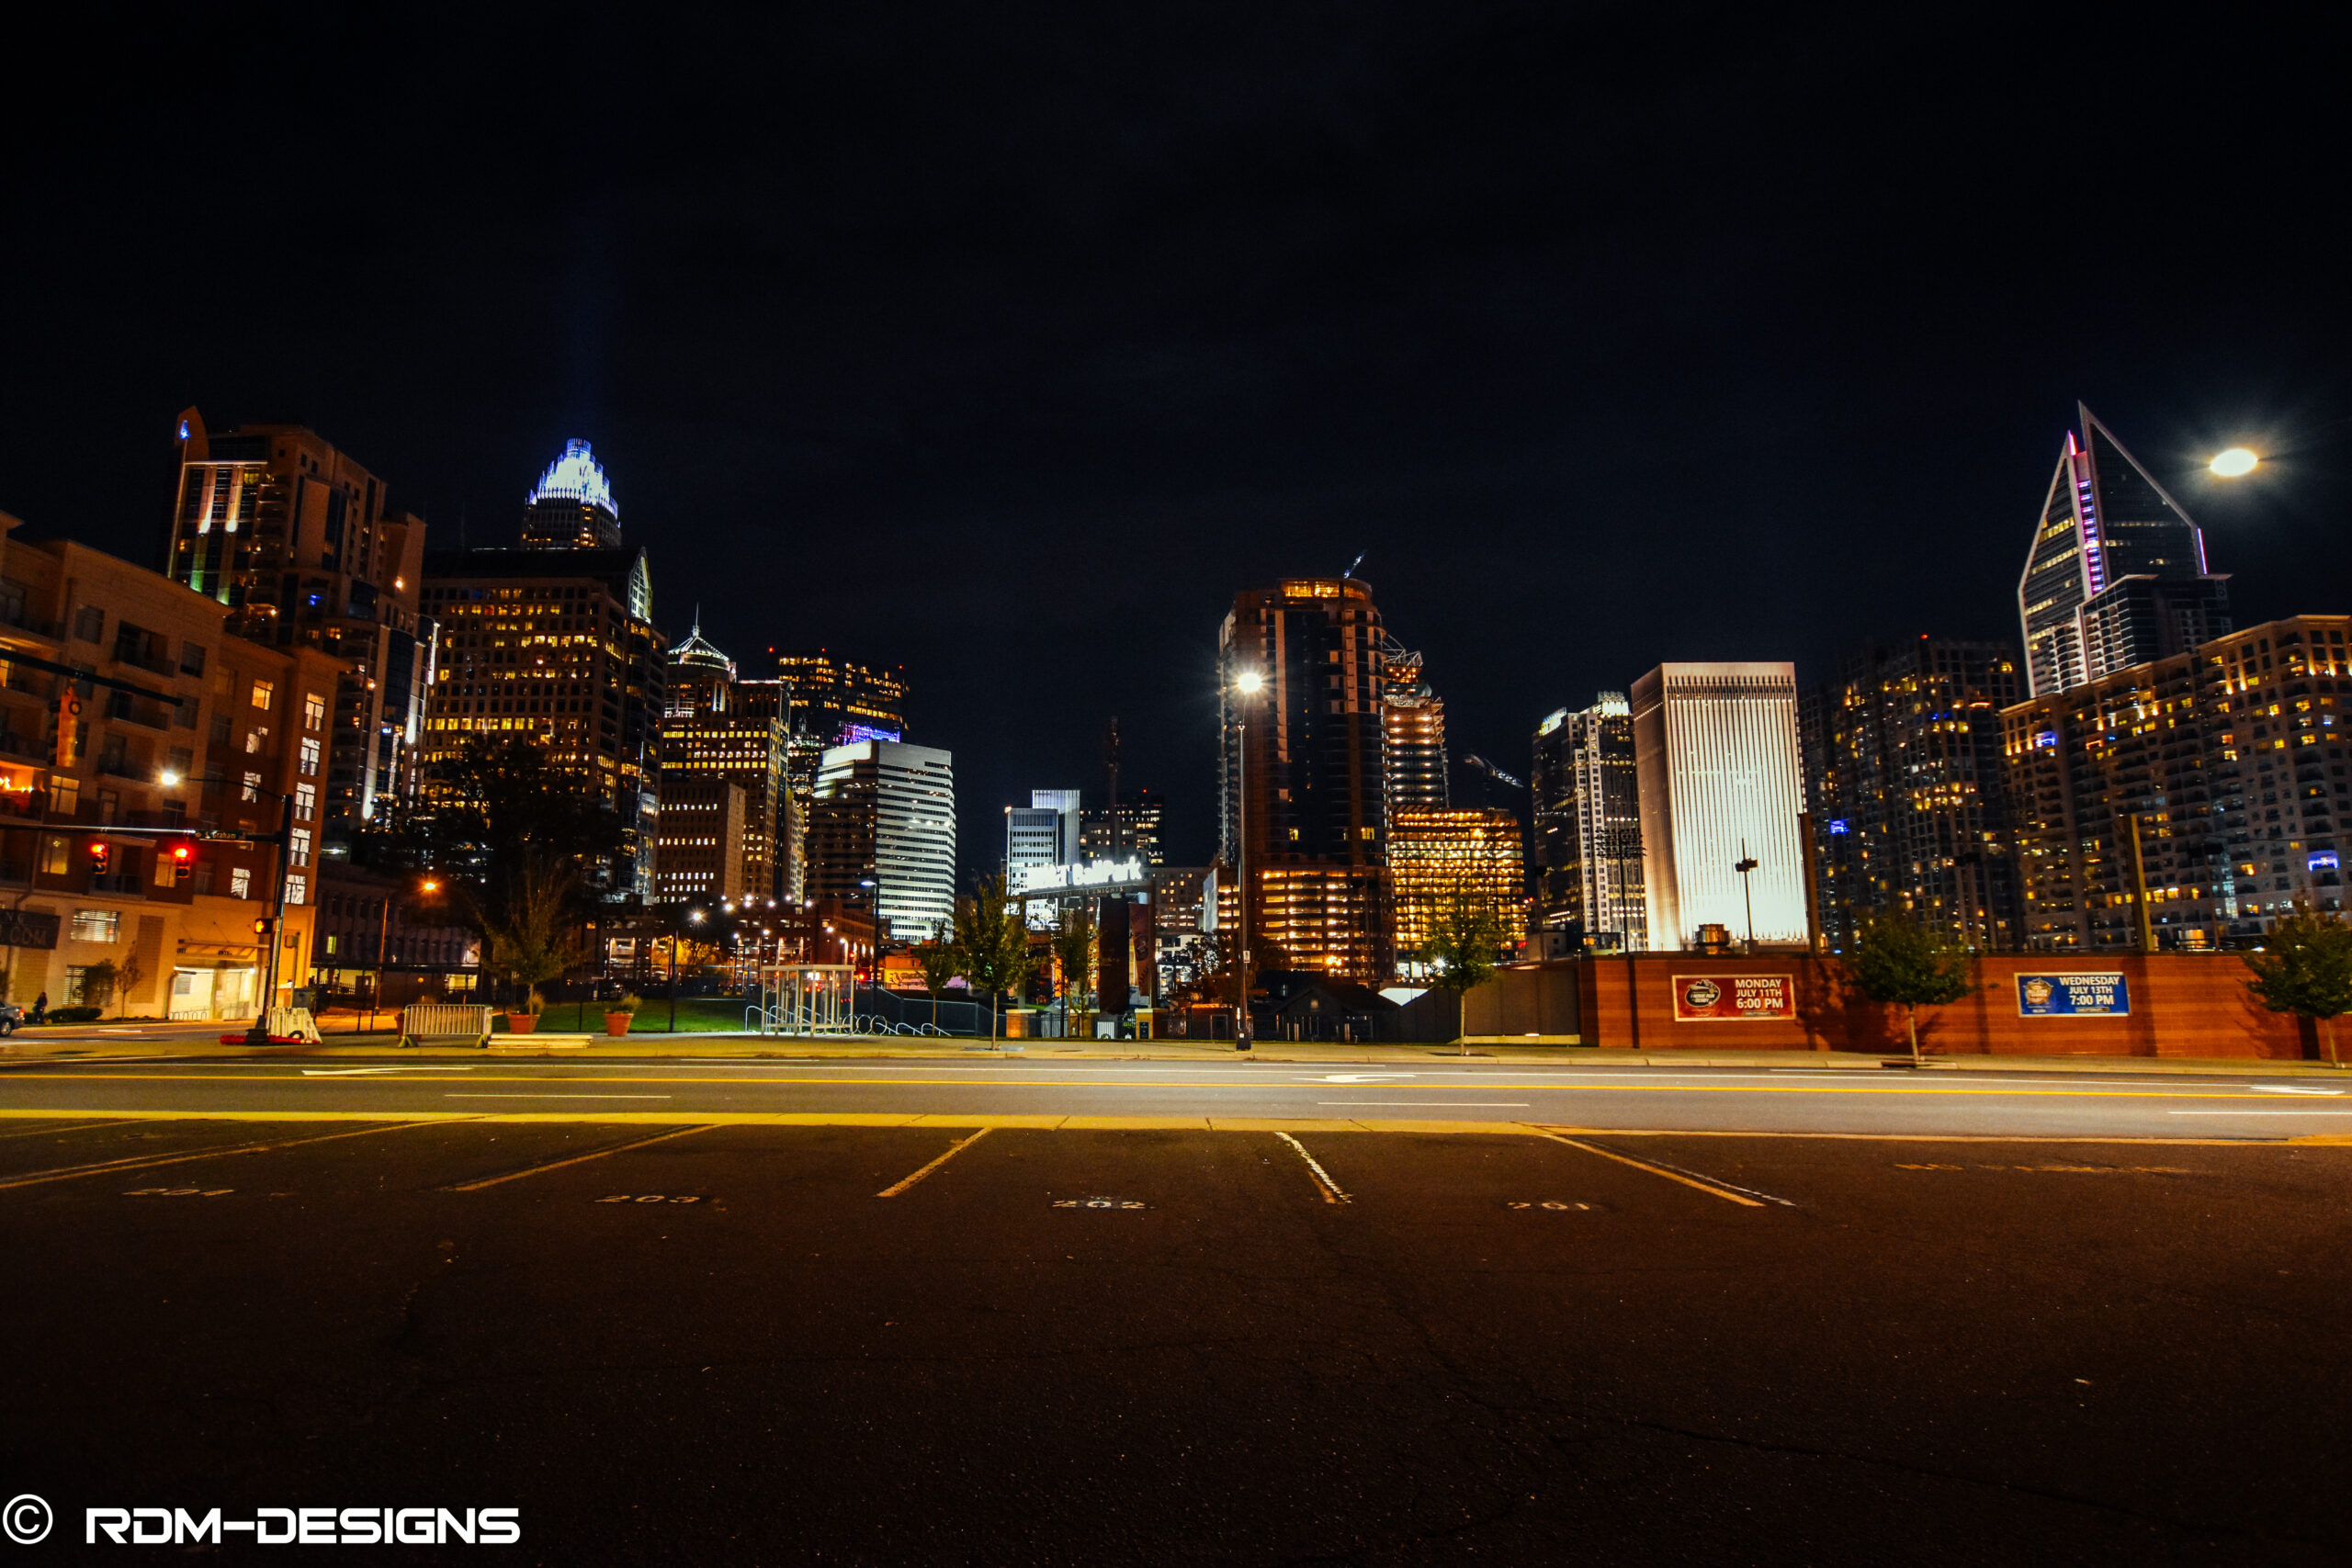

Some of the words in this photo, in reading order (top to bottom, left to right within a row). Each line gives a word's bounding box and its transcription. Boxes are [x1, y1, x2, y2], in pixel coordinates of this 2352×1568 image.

[1071, 856, 1142, 886] BallPark
[1736, 979, 1781, 988] MONDAY
[2059, 976, 2120, 986] WEDNESDAY
[1736, 988, 1757, 998] JULY
[1759, 988, 1782, 997] 11TH
[2069, 986, 2089, 995] JULY
[2091, 986, 2113, 994] 13TH
[1736, 998, 1762, 1010] 6:00
[1765, 998, 1783, 1009] PM
[2069, 995, 2094, 1006] 7:00
[2096, 995, 2115, 1006] PM
[1051, 1200, 1147, 1210] 202
